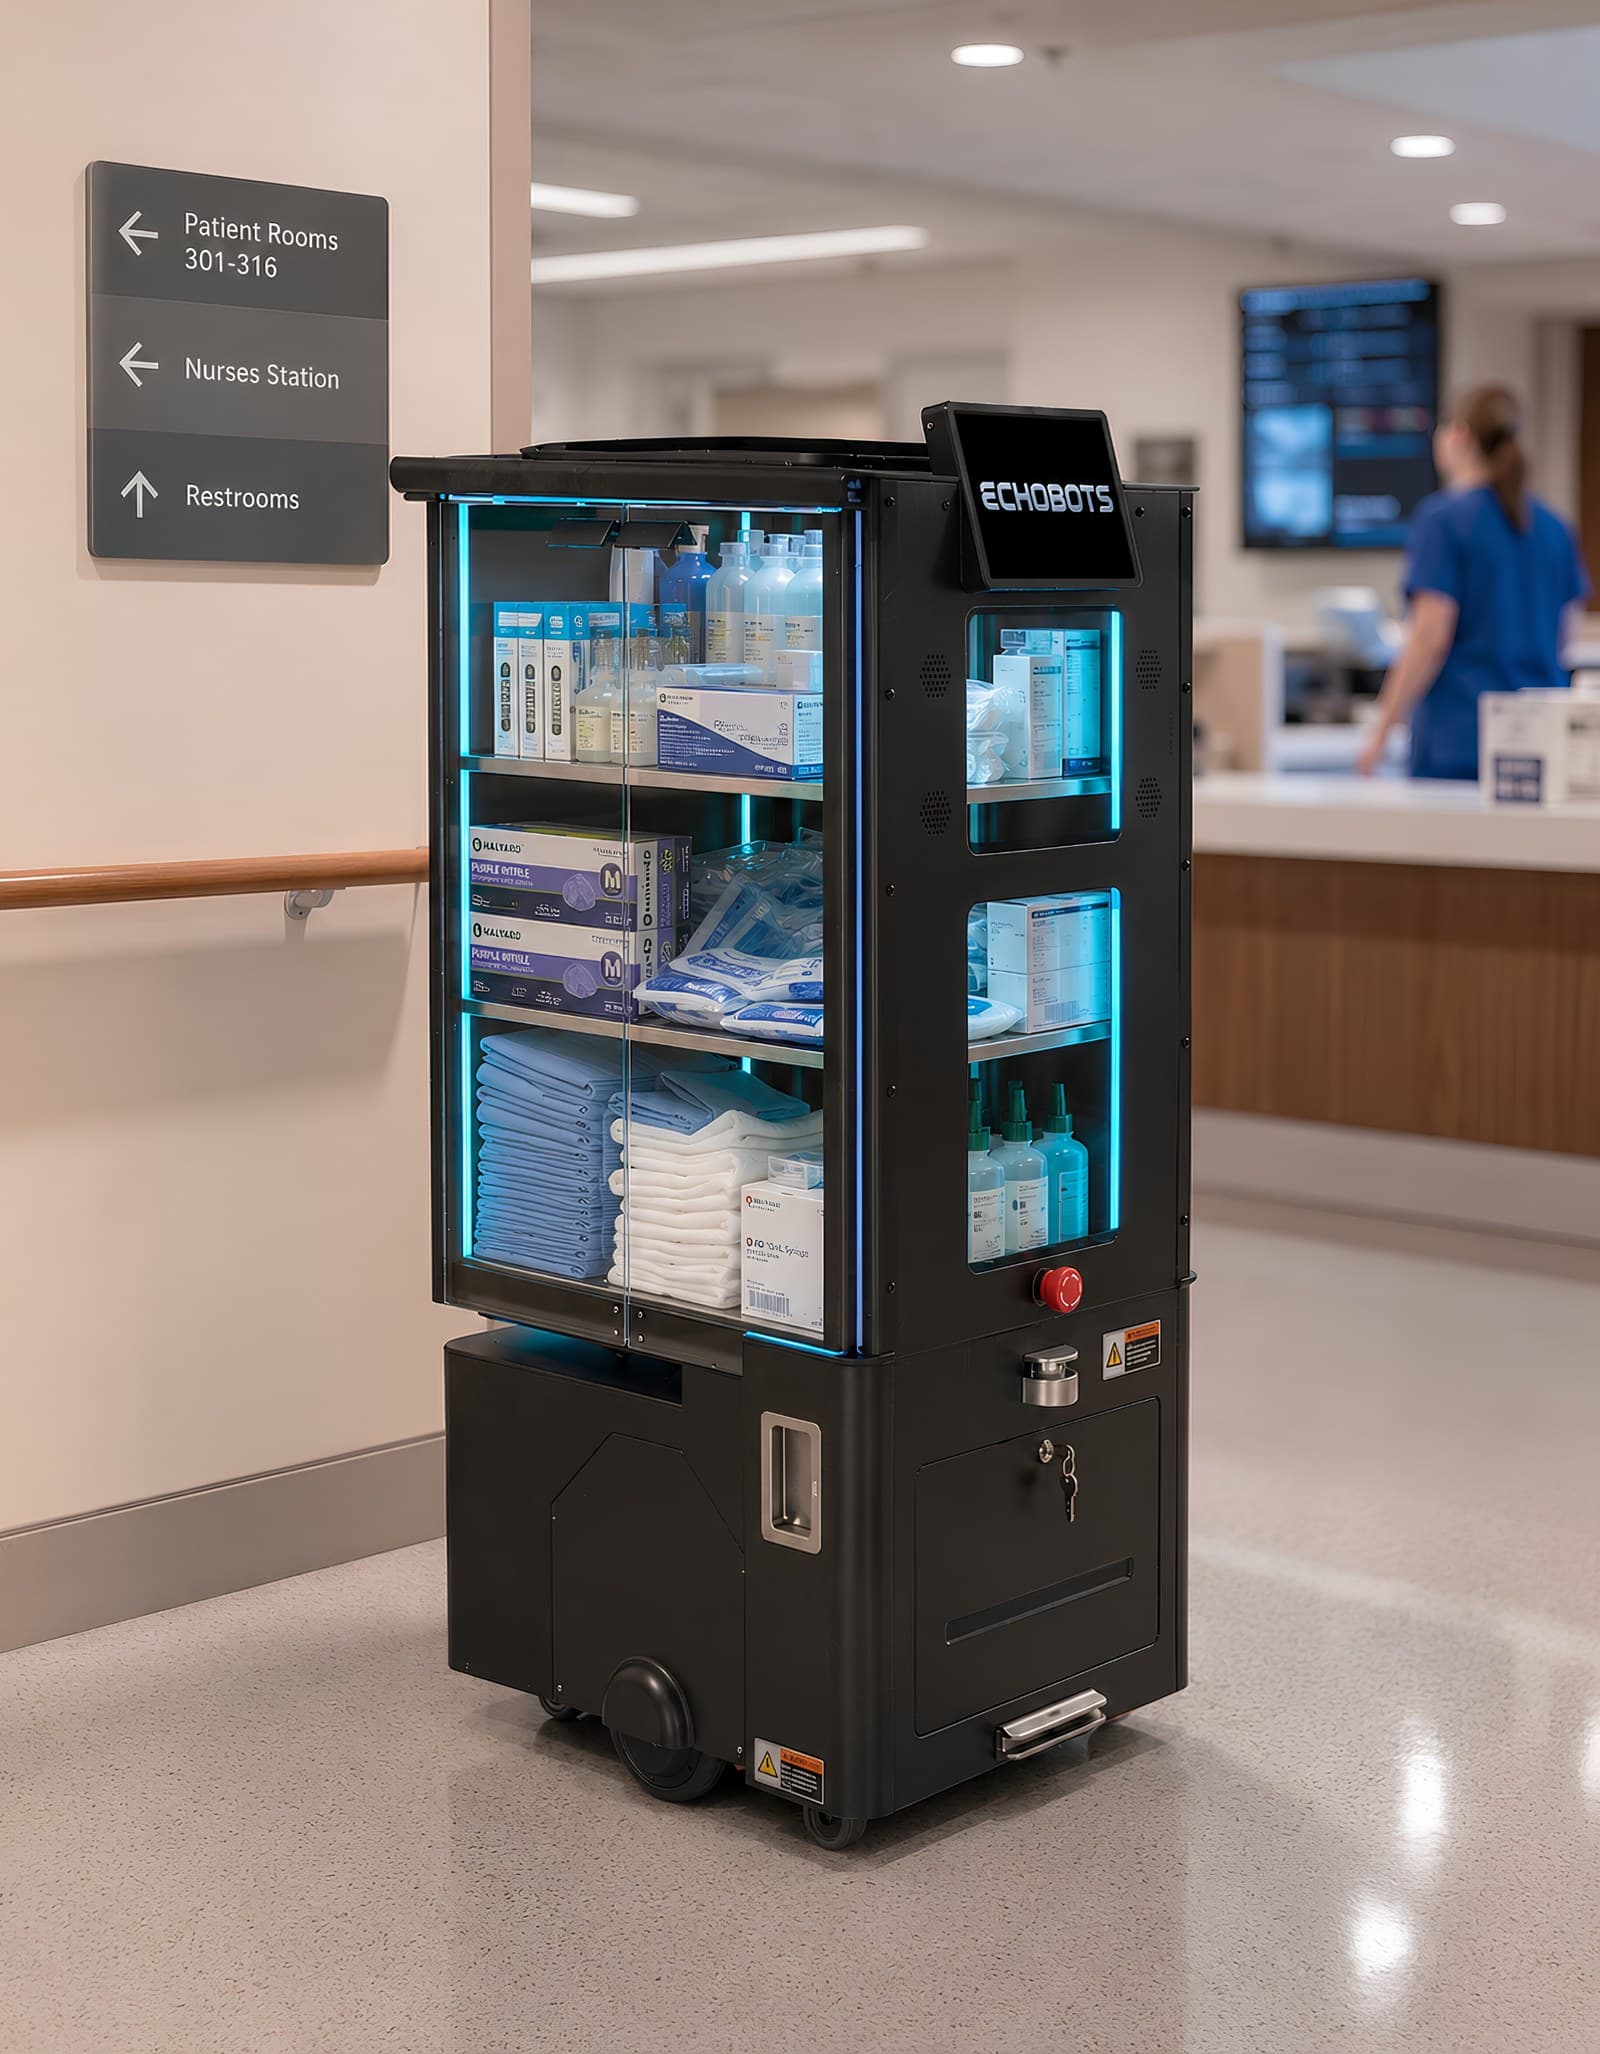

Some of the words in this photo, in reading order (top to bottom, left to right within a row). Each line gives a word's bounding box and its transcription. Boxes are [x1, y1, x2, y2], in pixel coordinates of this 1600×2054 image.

[185, 212, 262, 242] Patient
[268, 222, 339, 251] Rooms
[185, 247, 278, 279] 301-316
[185, 356, 260, 384] Nurses
[267, 363, 340, 390] Station
[186, 484, 300, 510] Restrooms
[979, 480, 1115, 513] ECHOBOTS
[604, 870, 621, 889] M
[604, 958, 621, 978] M
